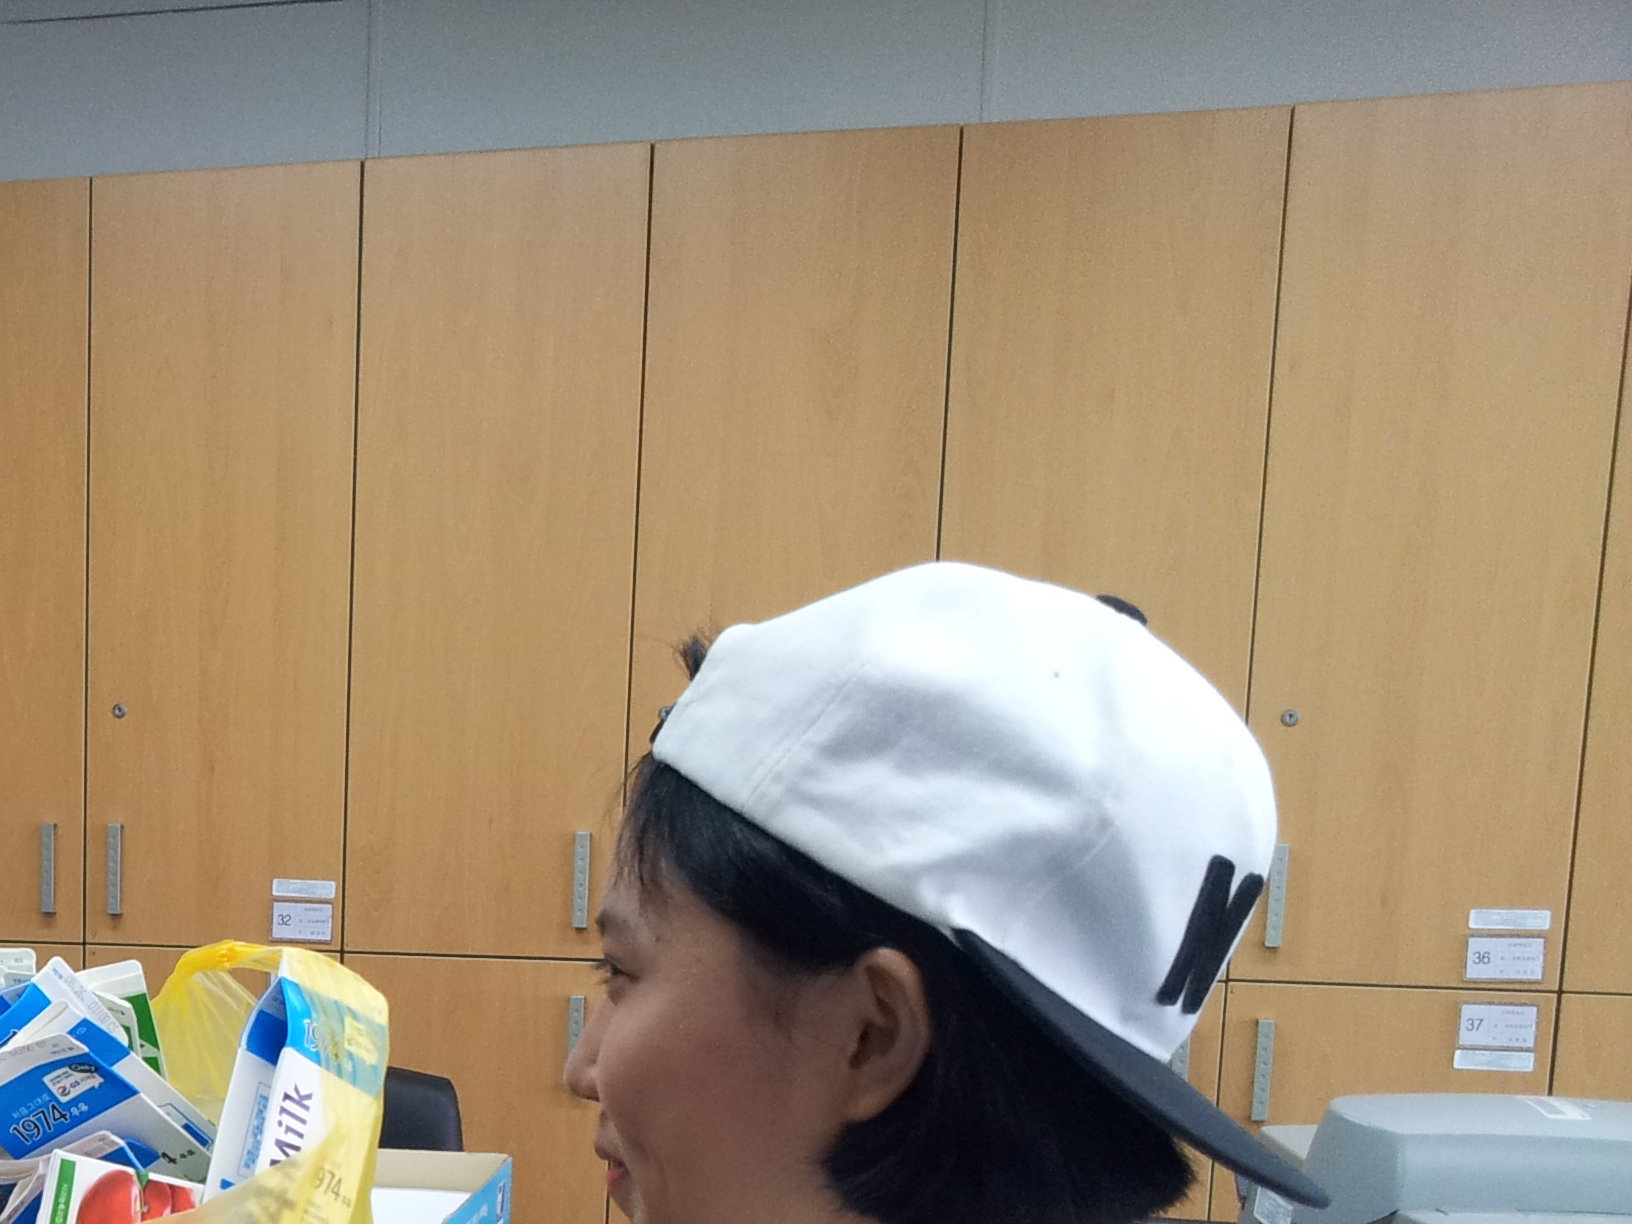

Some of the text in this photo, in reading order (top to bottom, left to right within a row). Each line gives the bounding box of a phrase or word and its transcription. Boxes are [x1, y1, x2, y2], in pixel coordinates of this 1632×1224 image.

[277, 913, 292, 927] 32
[1472, 951, 1491, 965] 36
[1465, 1018, 1484, 1032] 37
[10, 1101, 89, 1145] 1974 우유
[269, 1083, 313, 1167] Milk
